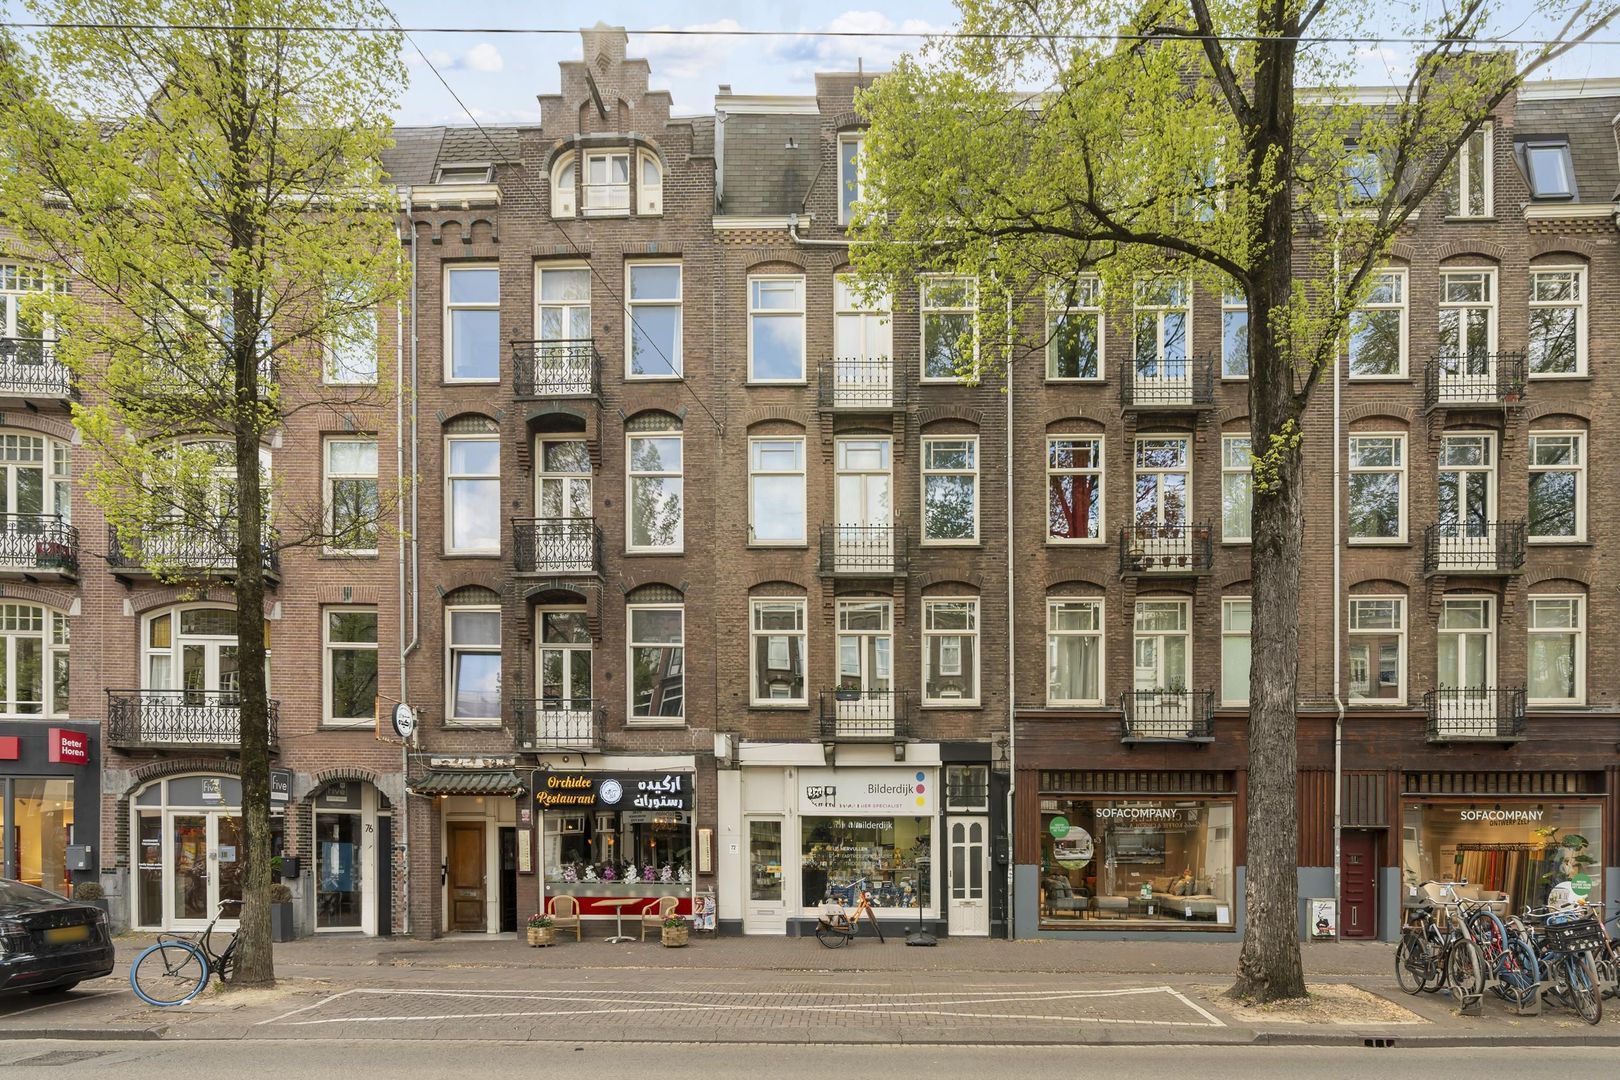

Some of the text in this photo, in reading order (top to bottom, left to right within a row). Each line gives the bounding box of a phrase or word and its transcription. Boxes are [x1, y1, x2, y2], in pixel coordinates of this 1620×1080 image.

[61, 738, 82, 748] Beter
[61, 746, 84, 757] Horen
[272, 775, 288, 791] five
[547, 775, 592, 789] Orchidee
[867, 783, 914, 796] Bilderdijk
[536, 790, 596, 806] Restaurant
[633, 794, 683, 809] رستوران
[1095, 808, 1178, 818] SOFACOMPANY
[1460, 810, 1544, 821] SOFACOMPANY
[365, 823, 374, 833] 76
